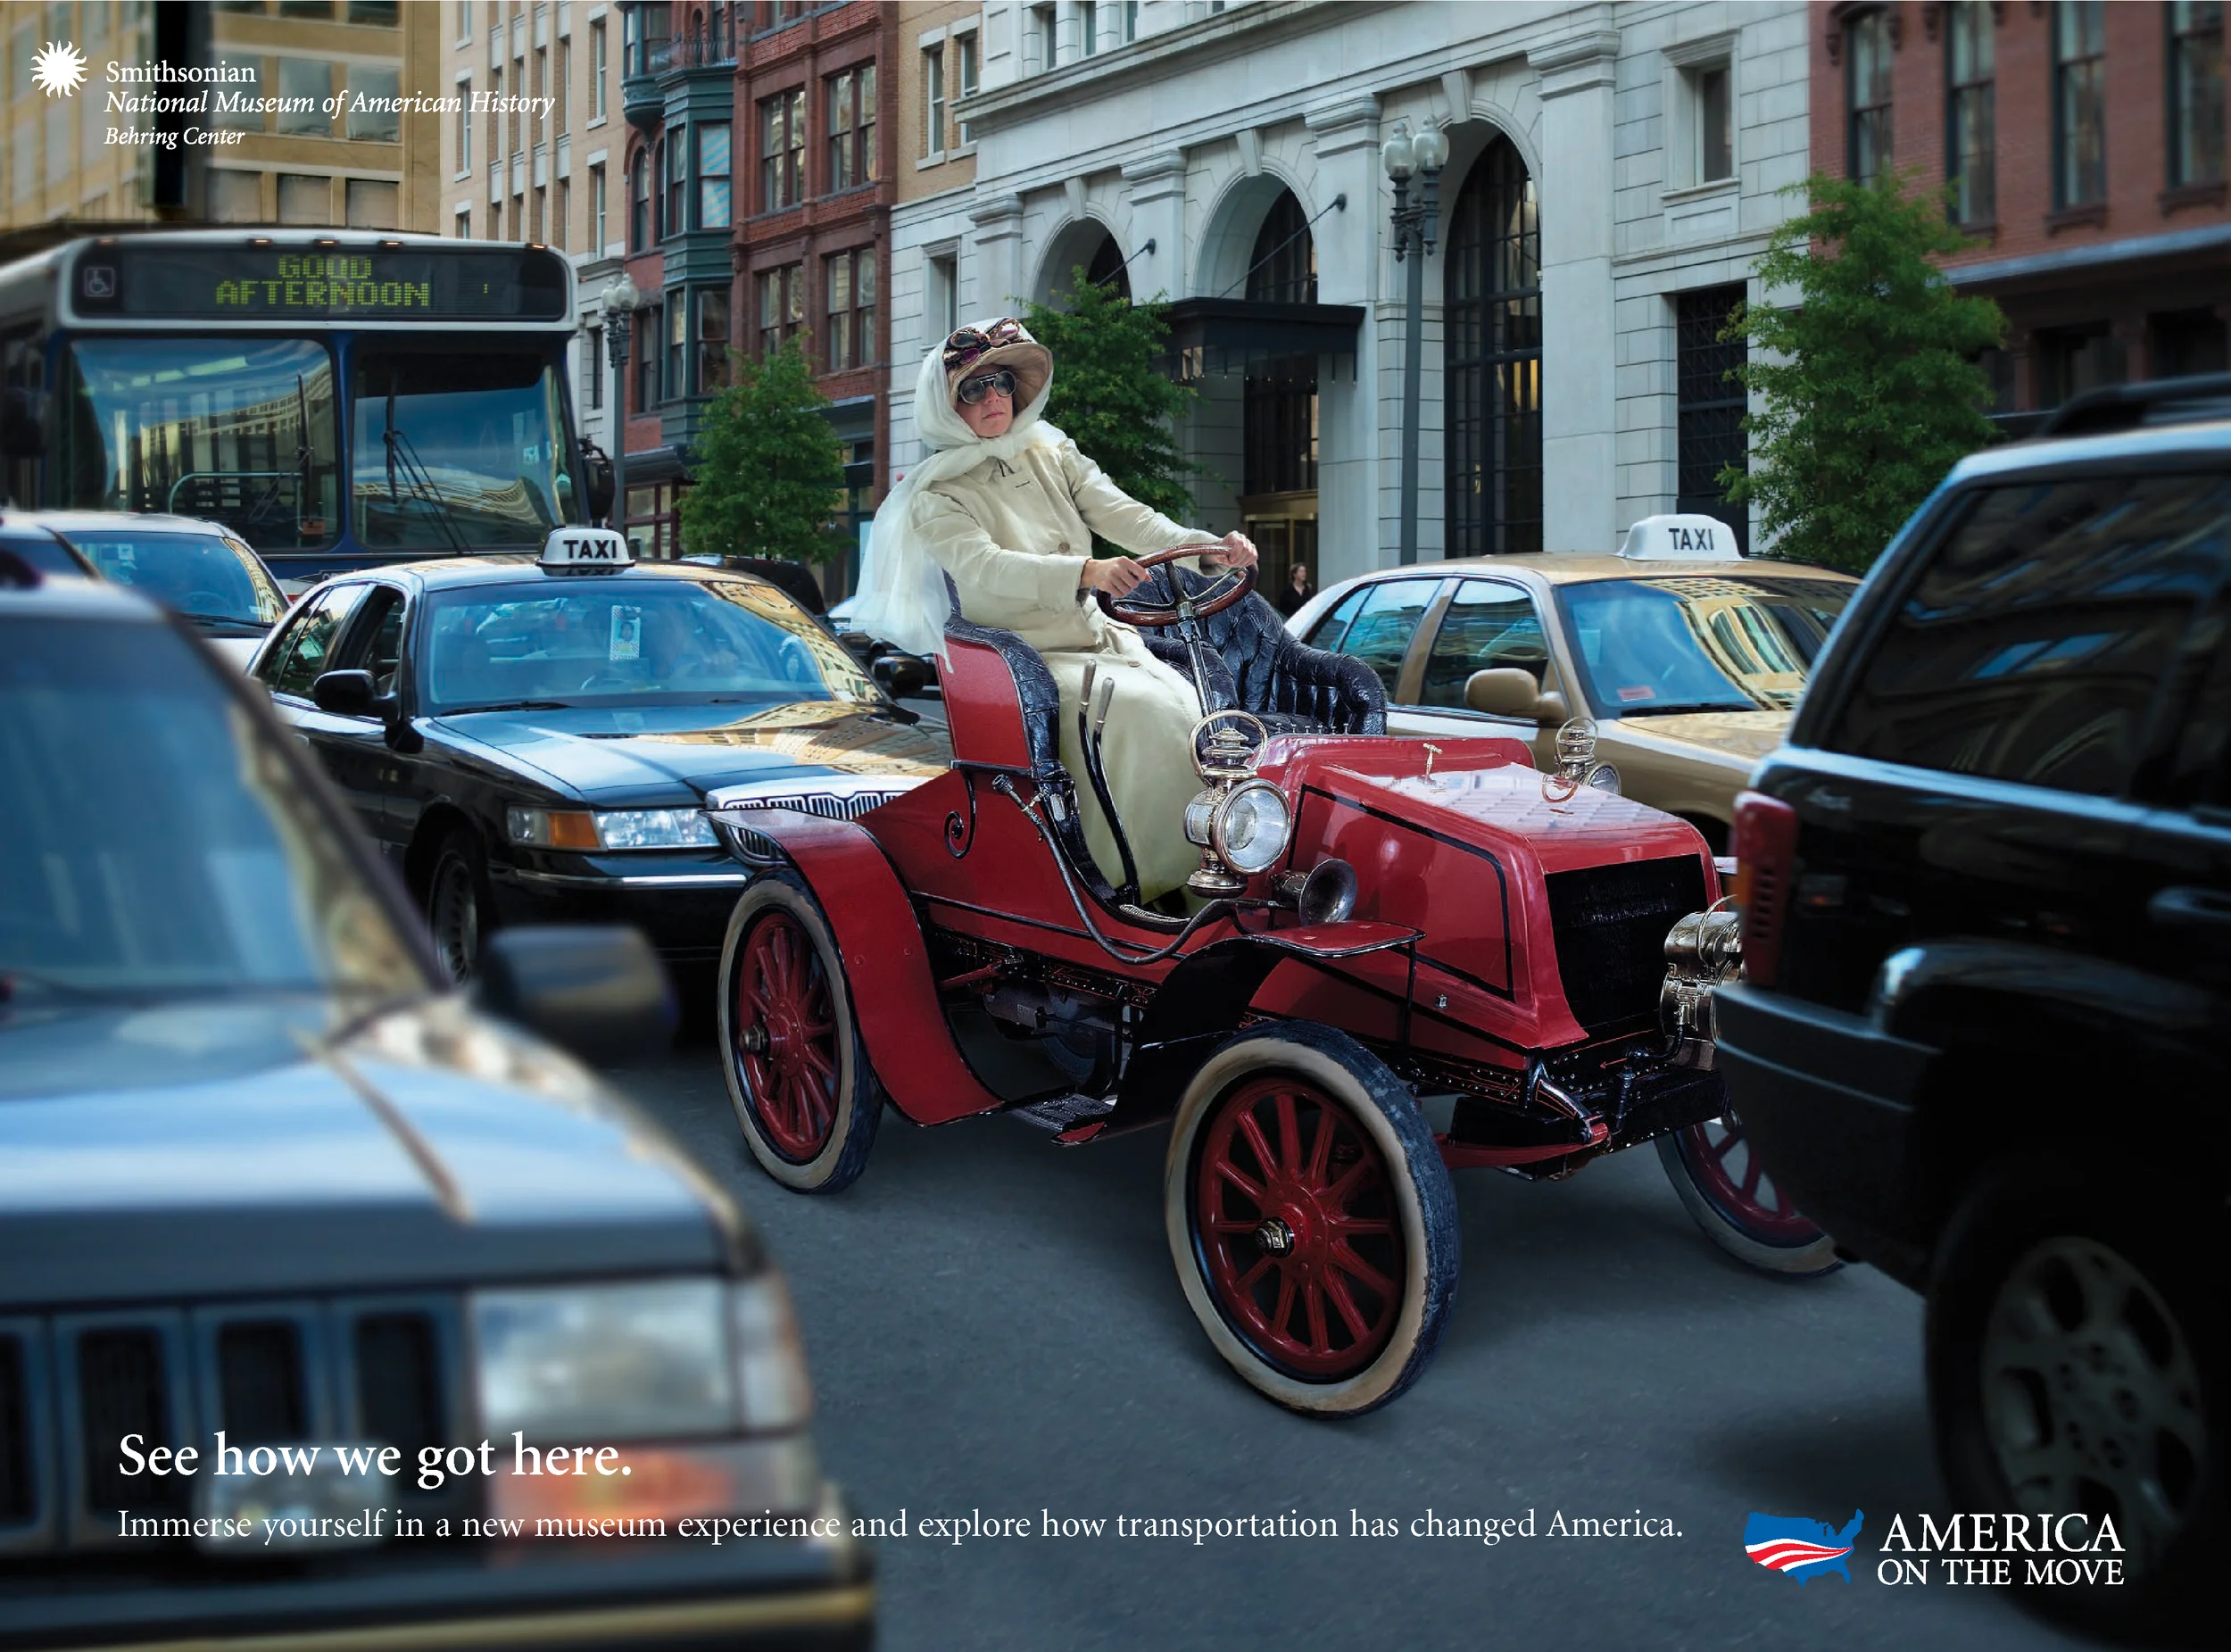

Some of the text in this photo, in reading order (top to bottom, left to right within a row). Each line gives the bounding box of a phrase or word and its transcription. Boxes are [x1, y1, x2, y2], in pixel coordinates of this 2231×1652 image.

[278, 254, 371, 279] GOOD
[216, 280, 429, 306] AFTERNOON
[563, 539, 617, 559] TAXI
[1668, 527, 1714, 551] TAXI
